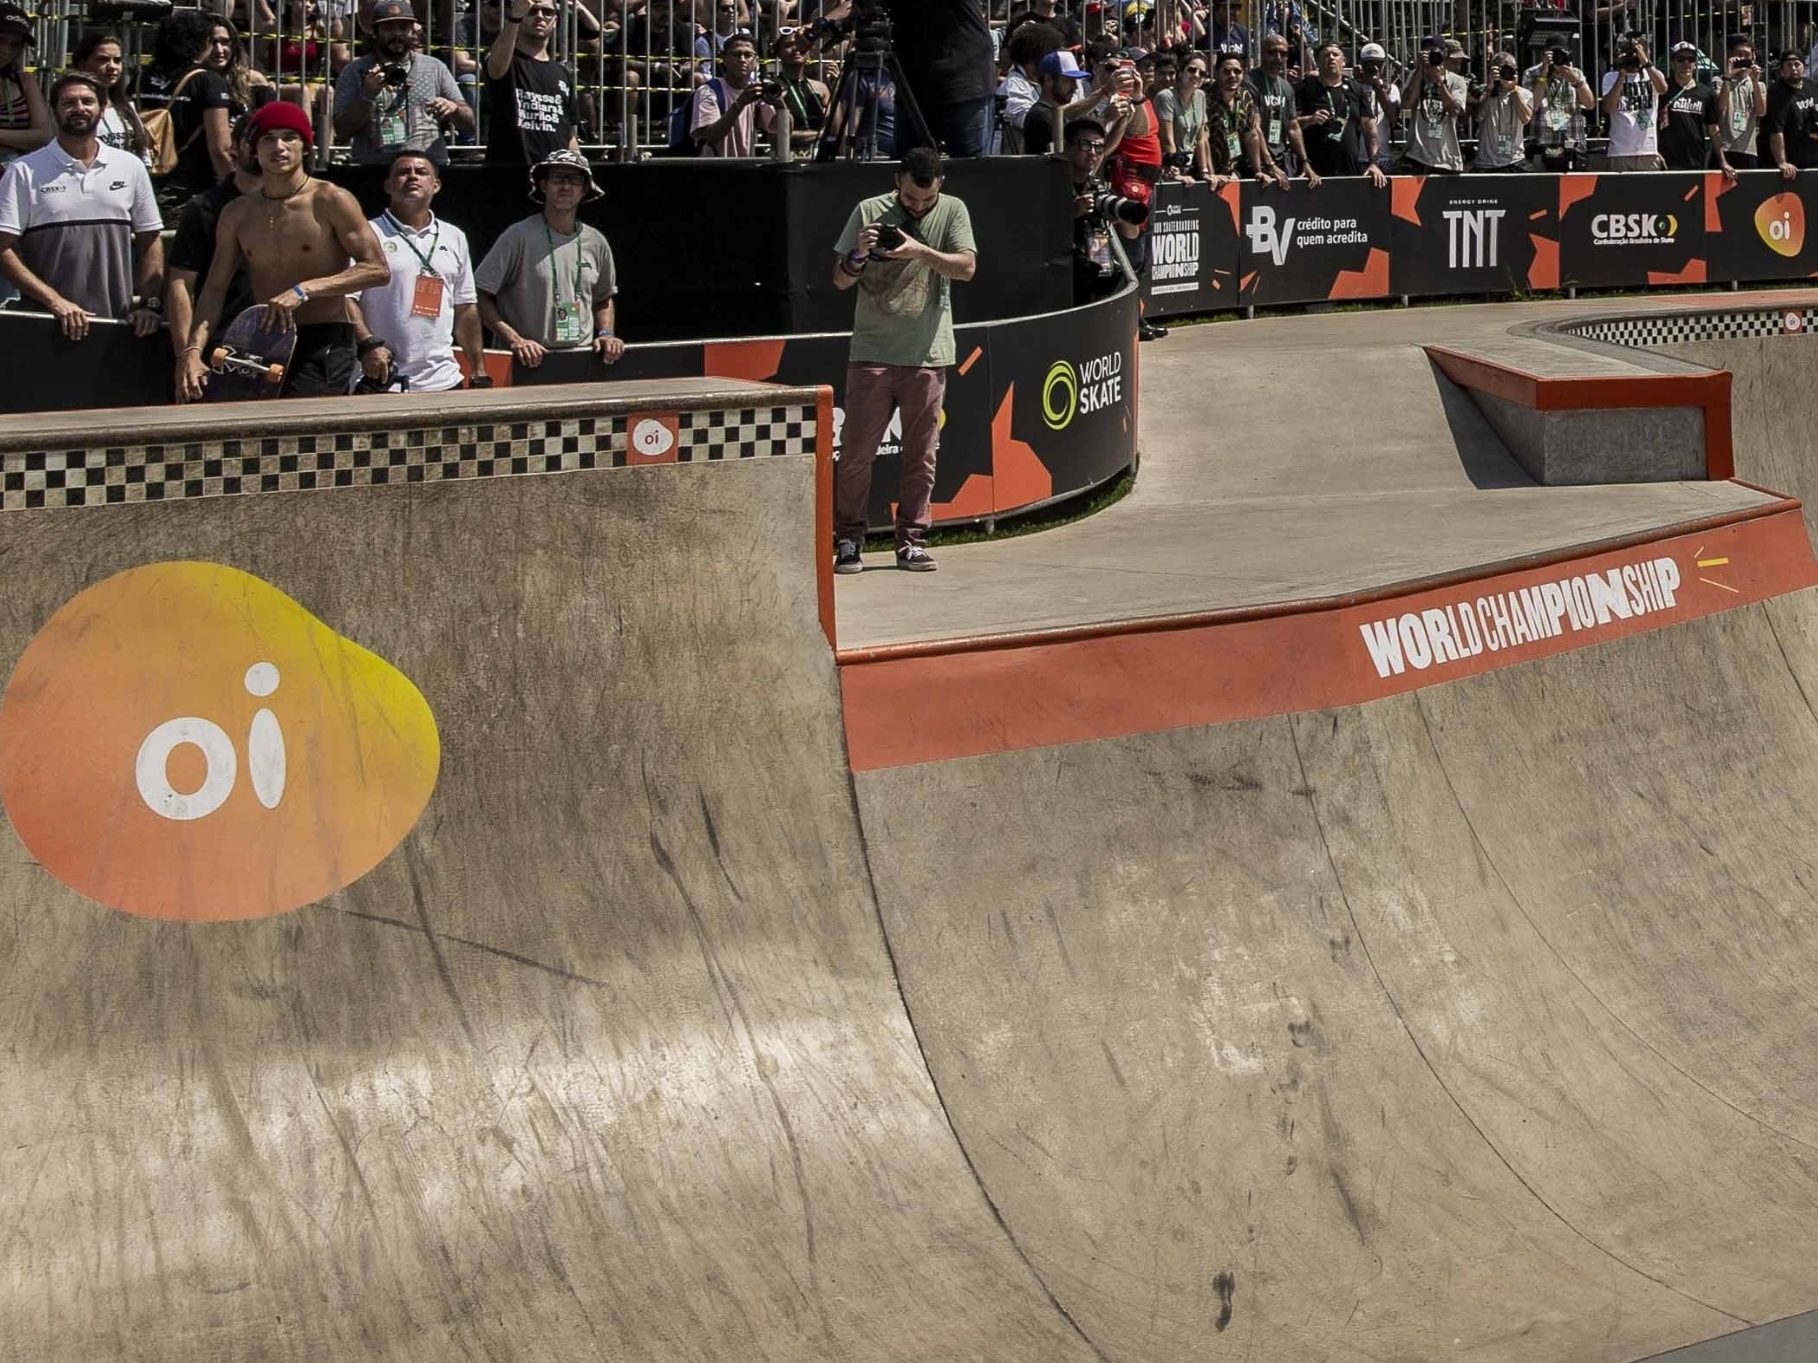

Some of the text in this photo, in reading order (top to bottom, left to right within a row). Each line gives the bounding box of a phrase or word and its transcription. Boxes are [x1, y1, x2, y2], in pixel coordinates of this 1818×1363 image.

[1246, 205, 1296, 266] BV
[1296, 230, 1368, 248] quem acredita
[1297, 218, 1357, 232] crédito para
[1443, 209, 1506, 268] TNT
[1591, 214, 1659, 238] CBSK
[1769, 211, 1790, 241] oi
[1152, 232, 1199, 265] WORLD
[1080, 351, 1122, 386] WORLD
[1080, 377, 1122, 415] SKATE
[644, 429, 659, 445] oi
[1360, 556, 1682, 678] WORLD CHAMPIONSHIP
[135, 661, 288, 821] oi
